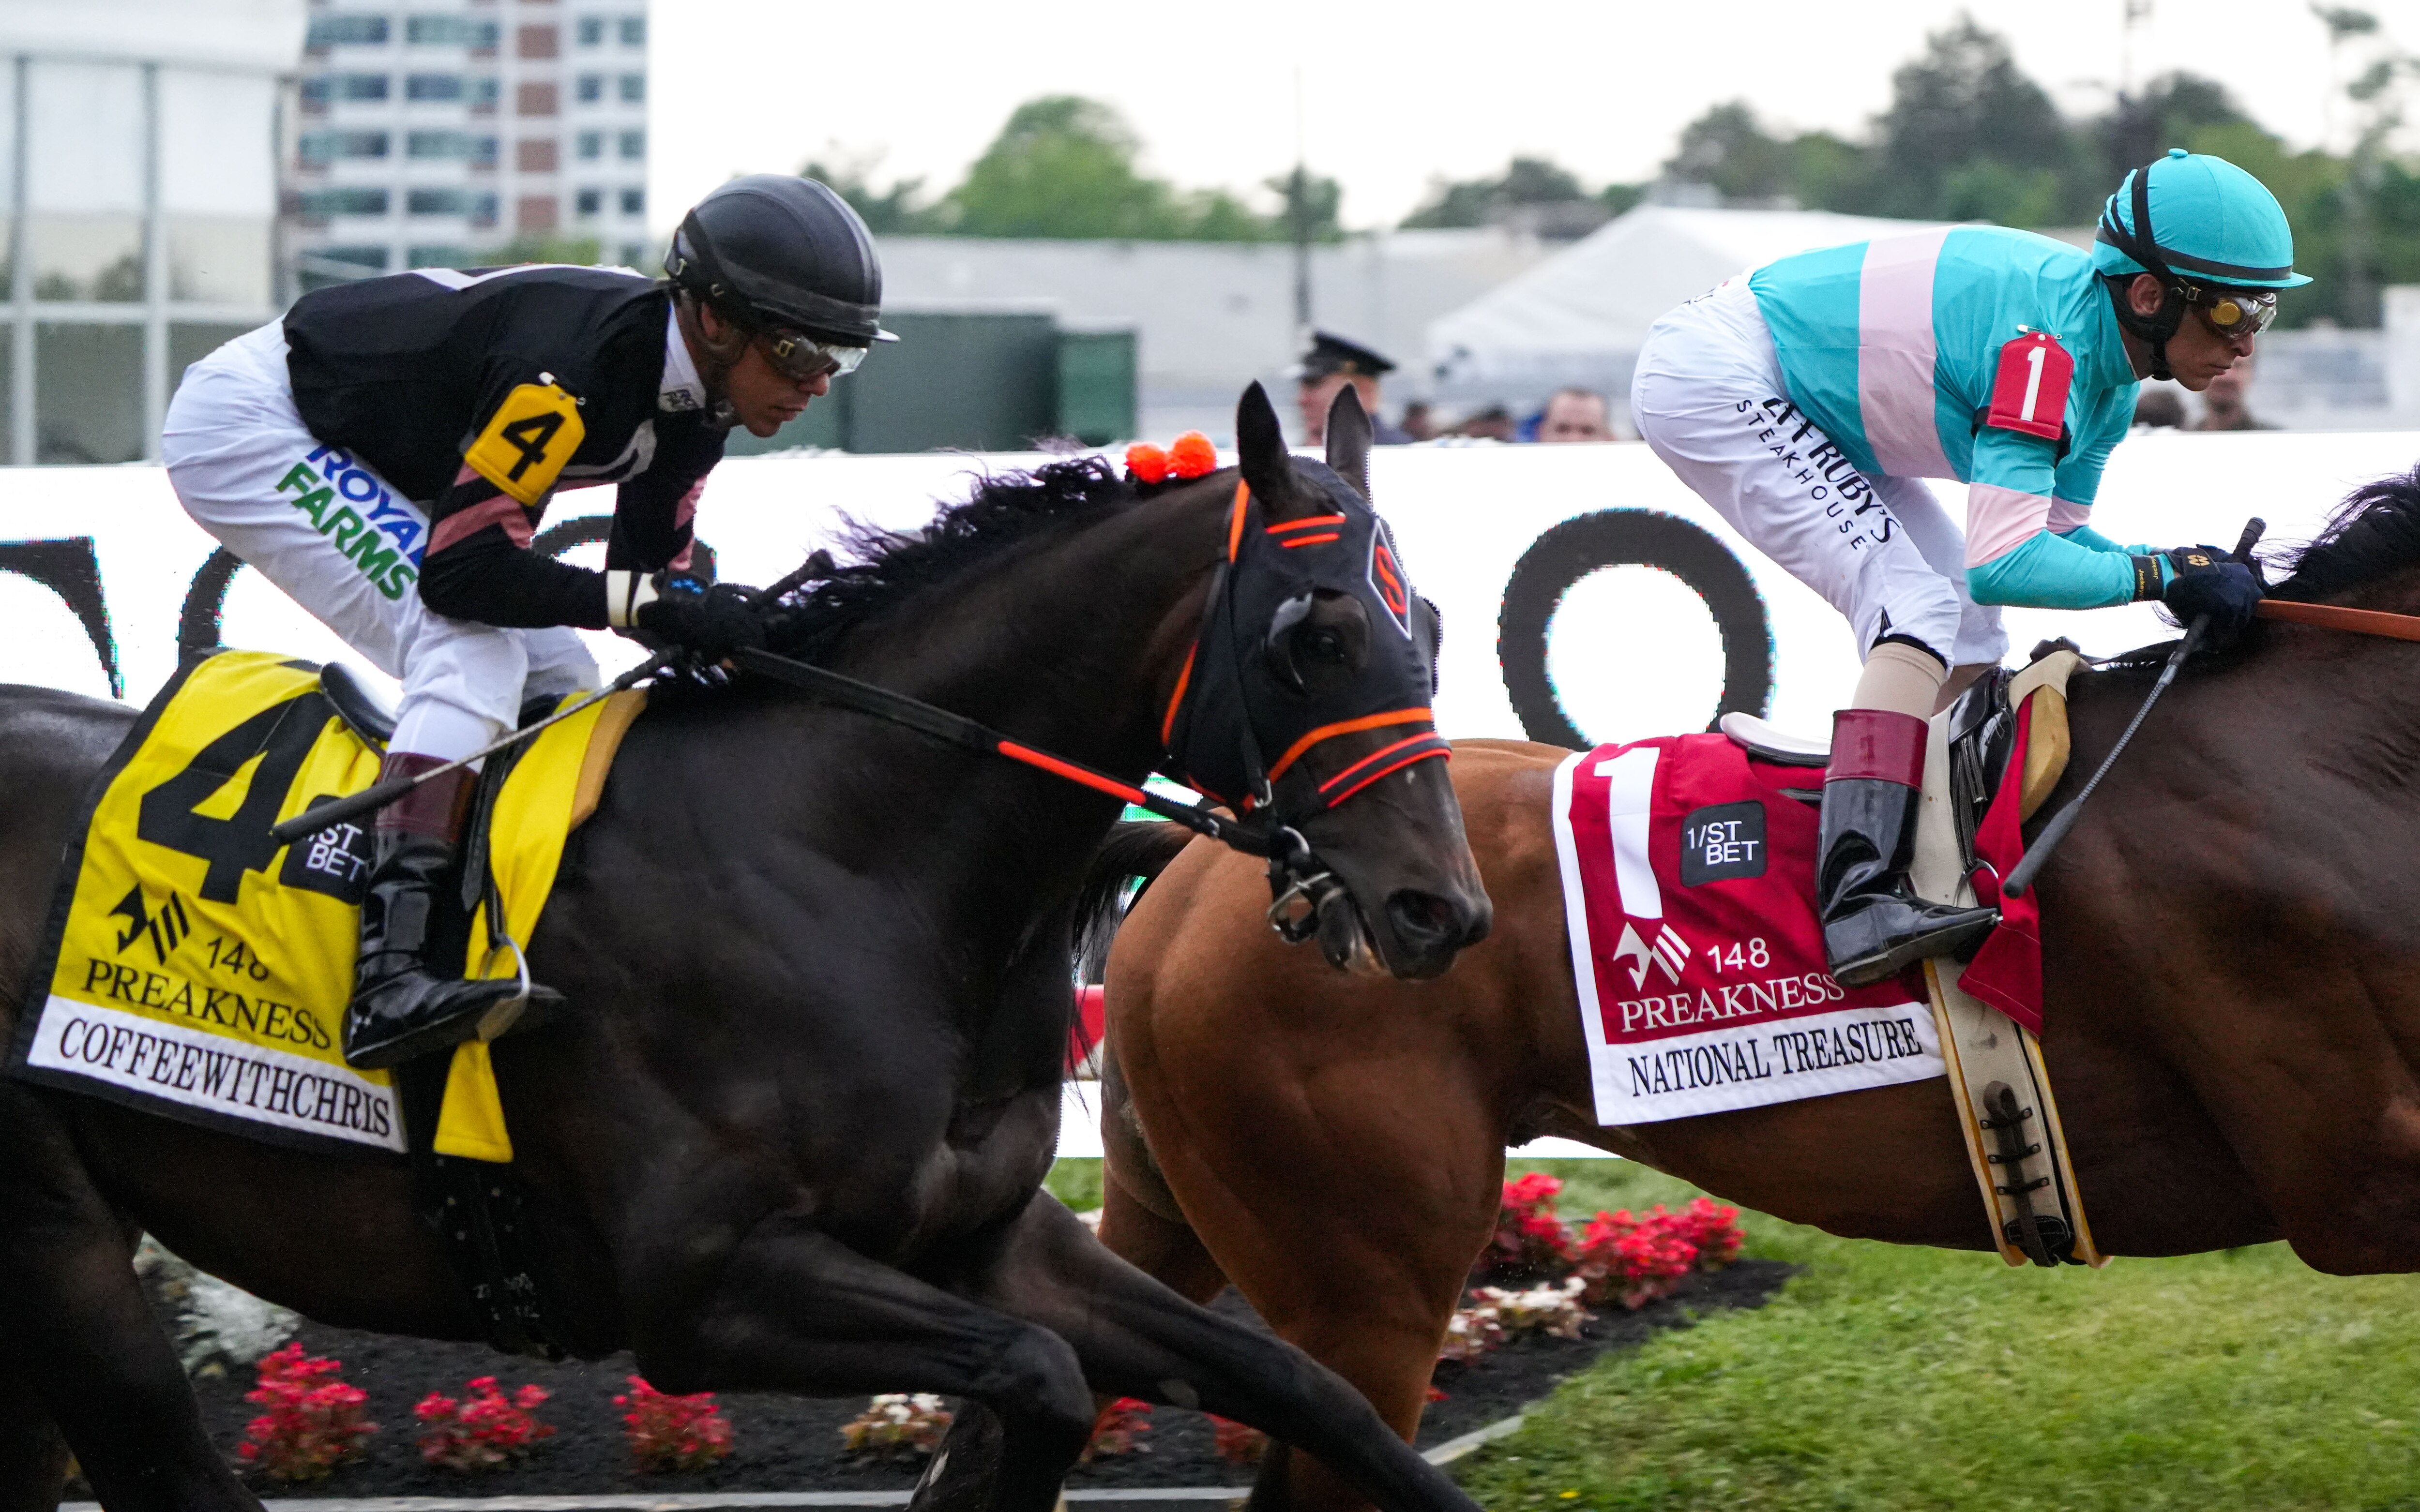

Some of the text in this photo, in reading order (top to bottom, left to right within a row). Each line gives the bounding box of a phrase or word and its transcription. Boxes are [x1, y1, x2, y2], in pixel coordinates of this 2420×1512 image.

[2020, 346, 2046, 422] 1
[500, 411, 566, 483] 4
[1737, 399, 1867, 550] STEAKHOUSE
[275, 462, 418, 600] FARMS
[305, 444, 426, 569] ROYA
[1808, 441, 1901, 543] RUBY'S
[137, 691, 332, 905] 4
[308, 823, 363, 851] ST
[1593, 747, 1664, 919] 1
[1687, 821, 1742, 850] 1/ST
[306, 842, 365, 883] BET
[1706, 840, 1759, 865] BET
[1707, 937, 1770, 973] 148
[80, 958, 331, 1050] PREAKNESS
[1618, 972, 1845, 1033] PREAKNESS
[60, 1017, 390, 1137] COFFEEWITHCHRIS
[1628, 1018, 1923, 1097] NATIONAL TREASURE
